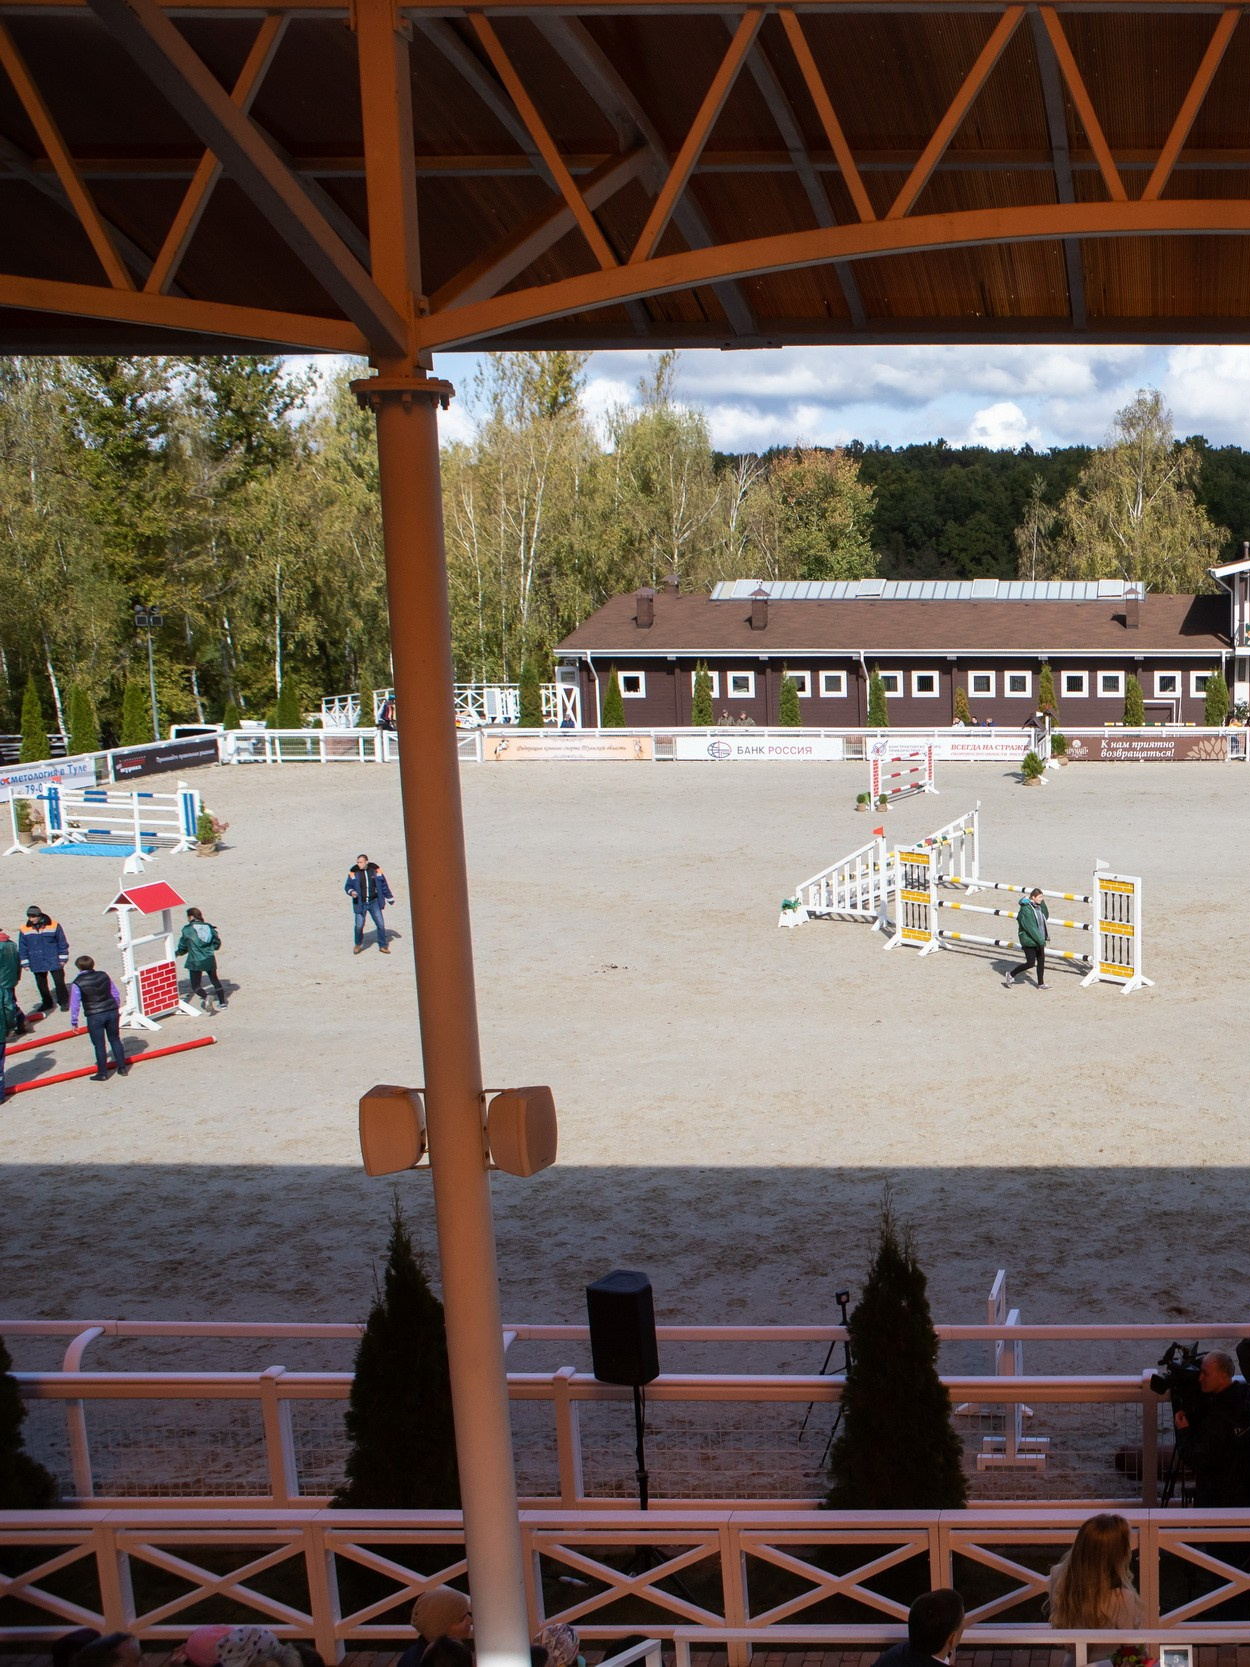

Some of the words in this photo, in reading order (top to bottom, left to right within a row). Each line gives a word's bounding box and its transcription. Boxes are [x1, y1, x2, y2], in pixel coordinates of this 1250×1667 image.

[1101, 740, 1109, 748] К
[1131, 741, 1175, 750] приятно
[737, 746, 765, 755] БАНК
[768, 746, 812, 755] РОССИЯ
[1101, 749, 1175, 759] возвращаться!
[0, 769, 59, 786] осметология
[60, 768, 66, 776] в
[67, 764, 87, 776] Туле
